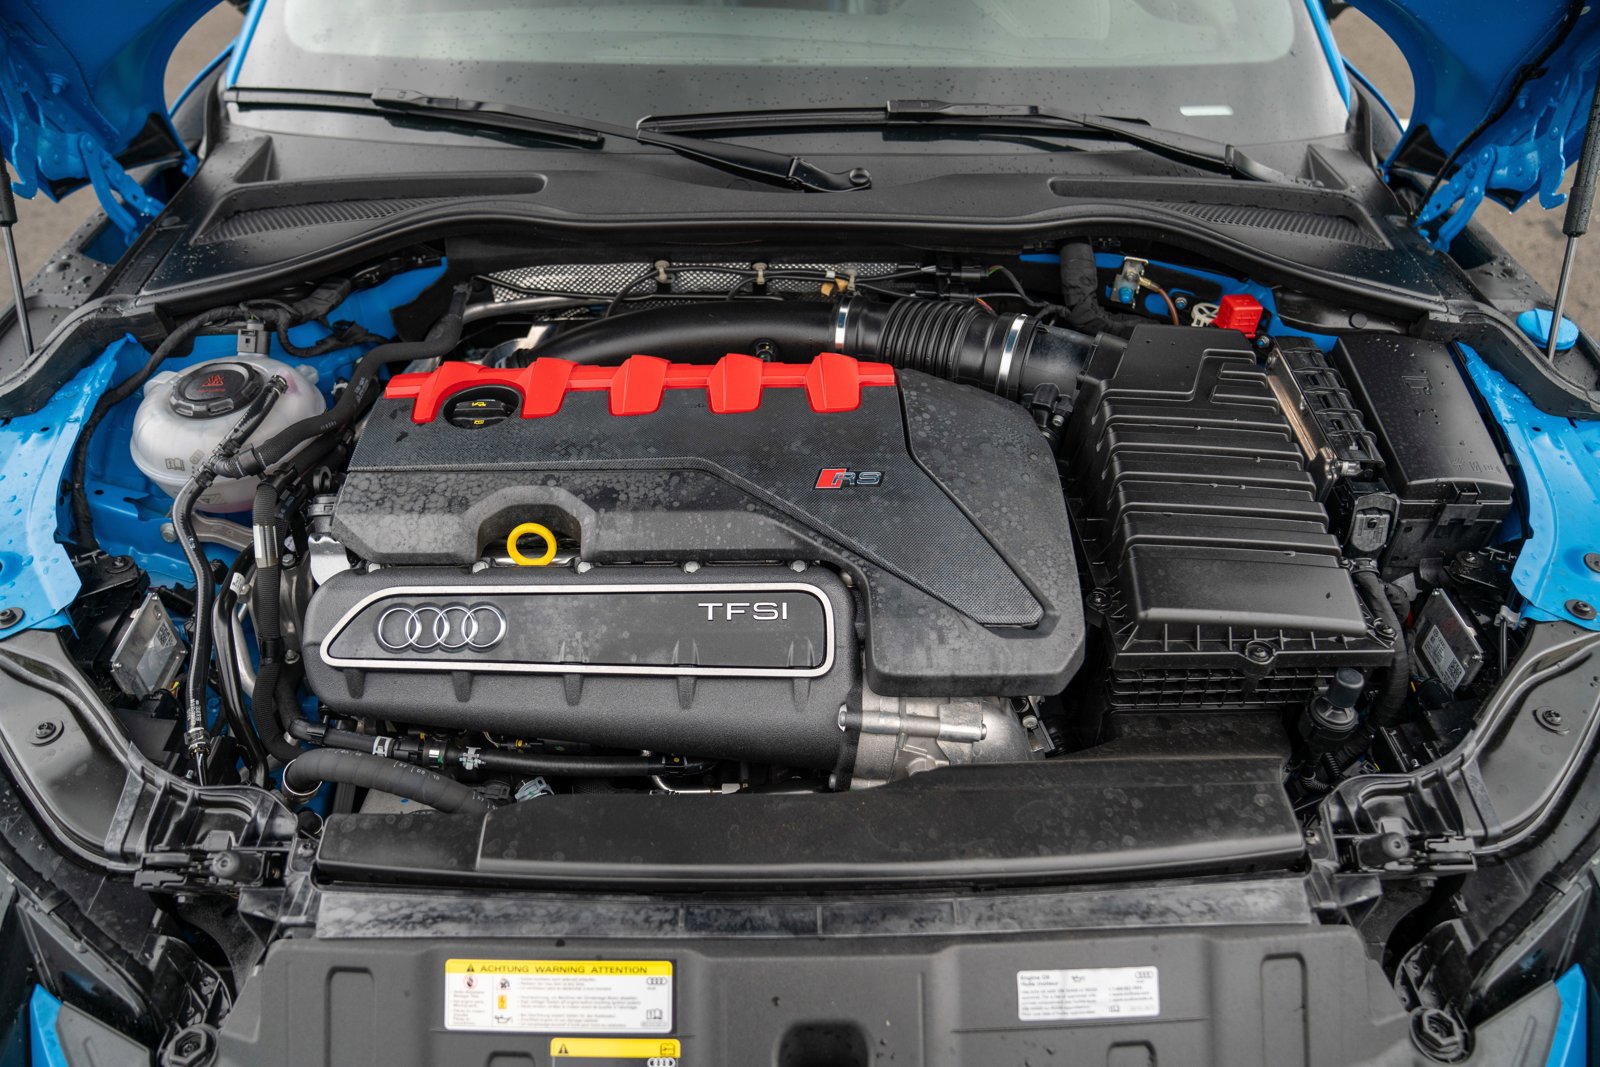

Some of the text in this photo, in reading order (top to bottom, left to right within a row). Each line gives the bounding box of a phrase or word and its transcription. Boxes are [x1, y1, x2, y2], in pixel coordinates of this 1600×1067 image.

[831, 471, 882, 486] RS
[697, 602, 788, 621] TFSI
[480, 965, 648, 975] ACHTUNG WARNING ATTENTION
